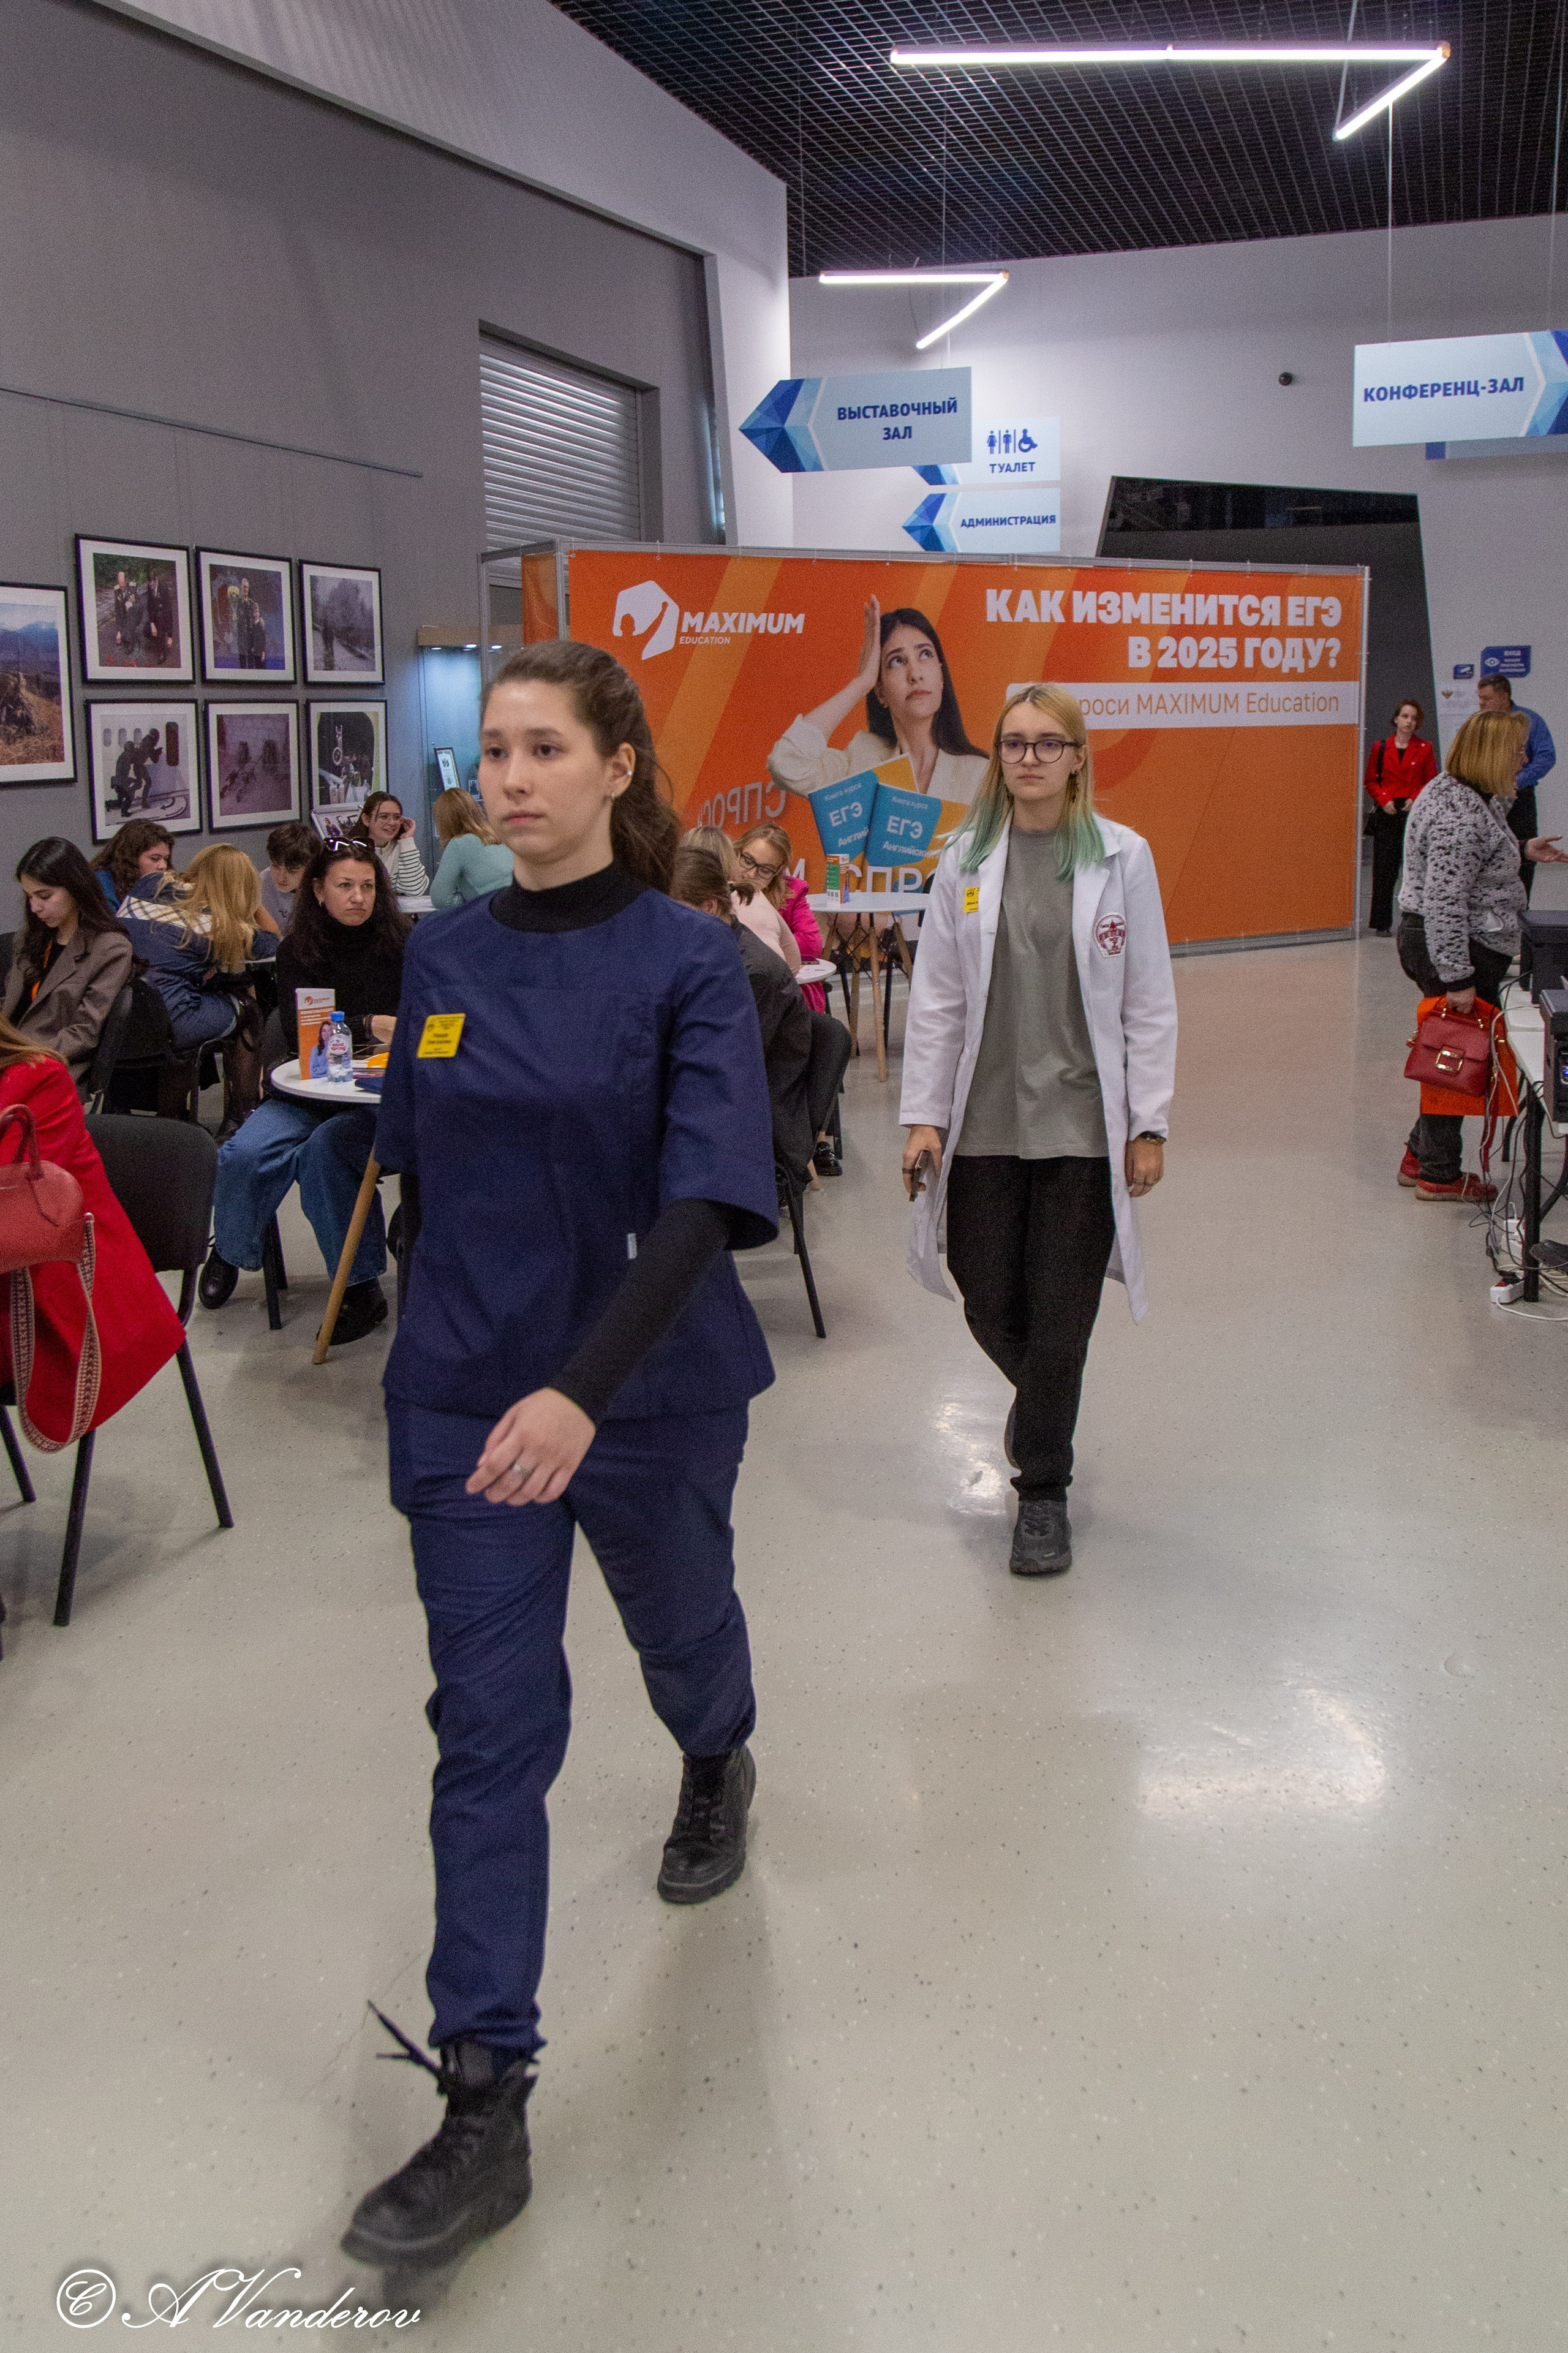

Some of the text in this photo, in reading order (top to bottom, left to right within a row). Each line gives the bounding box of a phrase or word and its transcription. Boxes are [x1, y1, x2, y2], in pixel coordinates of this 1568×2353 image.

[1364, 377, 1525, 402] КОНФЕРЕНЦ-ЗАЛ
[837, 396, 957, 420] ВЫСТАВОЧНЫЙ
[883, 426, 913, 440] ЗАЛ
[989, 461, 1036, 474] ТУАЛЕТ
[960, 515, 1057, 529] АДМИНИСТРАЦИЯ
[986, 589, 1342, 627] КАК ИЗМЕНИТСЯ ЕГЭ
[681, 611, 805, 634] MAXIMUM
[679, 636, 731, 644] EDUCATION
[1128, 636, 1341, 673] В 2025 ГОДУ?
[1079, 692, 1339, 716] роси MAXIMUM Education
[829, 802, 863, 827] ЕГЭ
[838, 828, 869, 847] Англий
[886, 815, 923, 839] ЕГЭ
[883, 840, 932, 858] Английски
